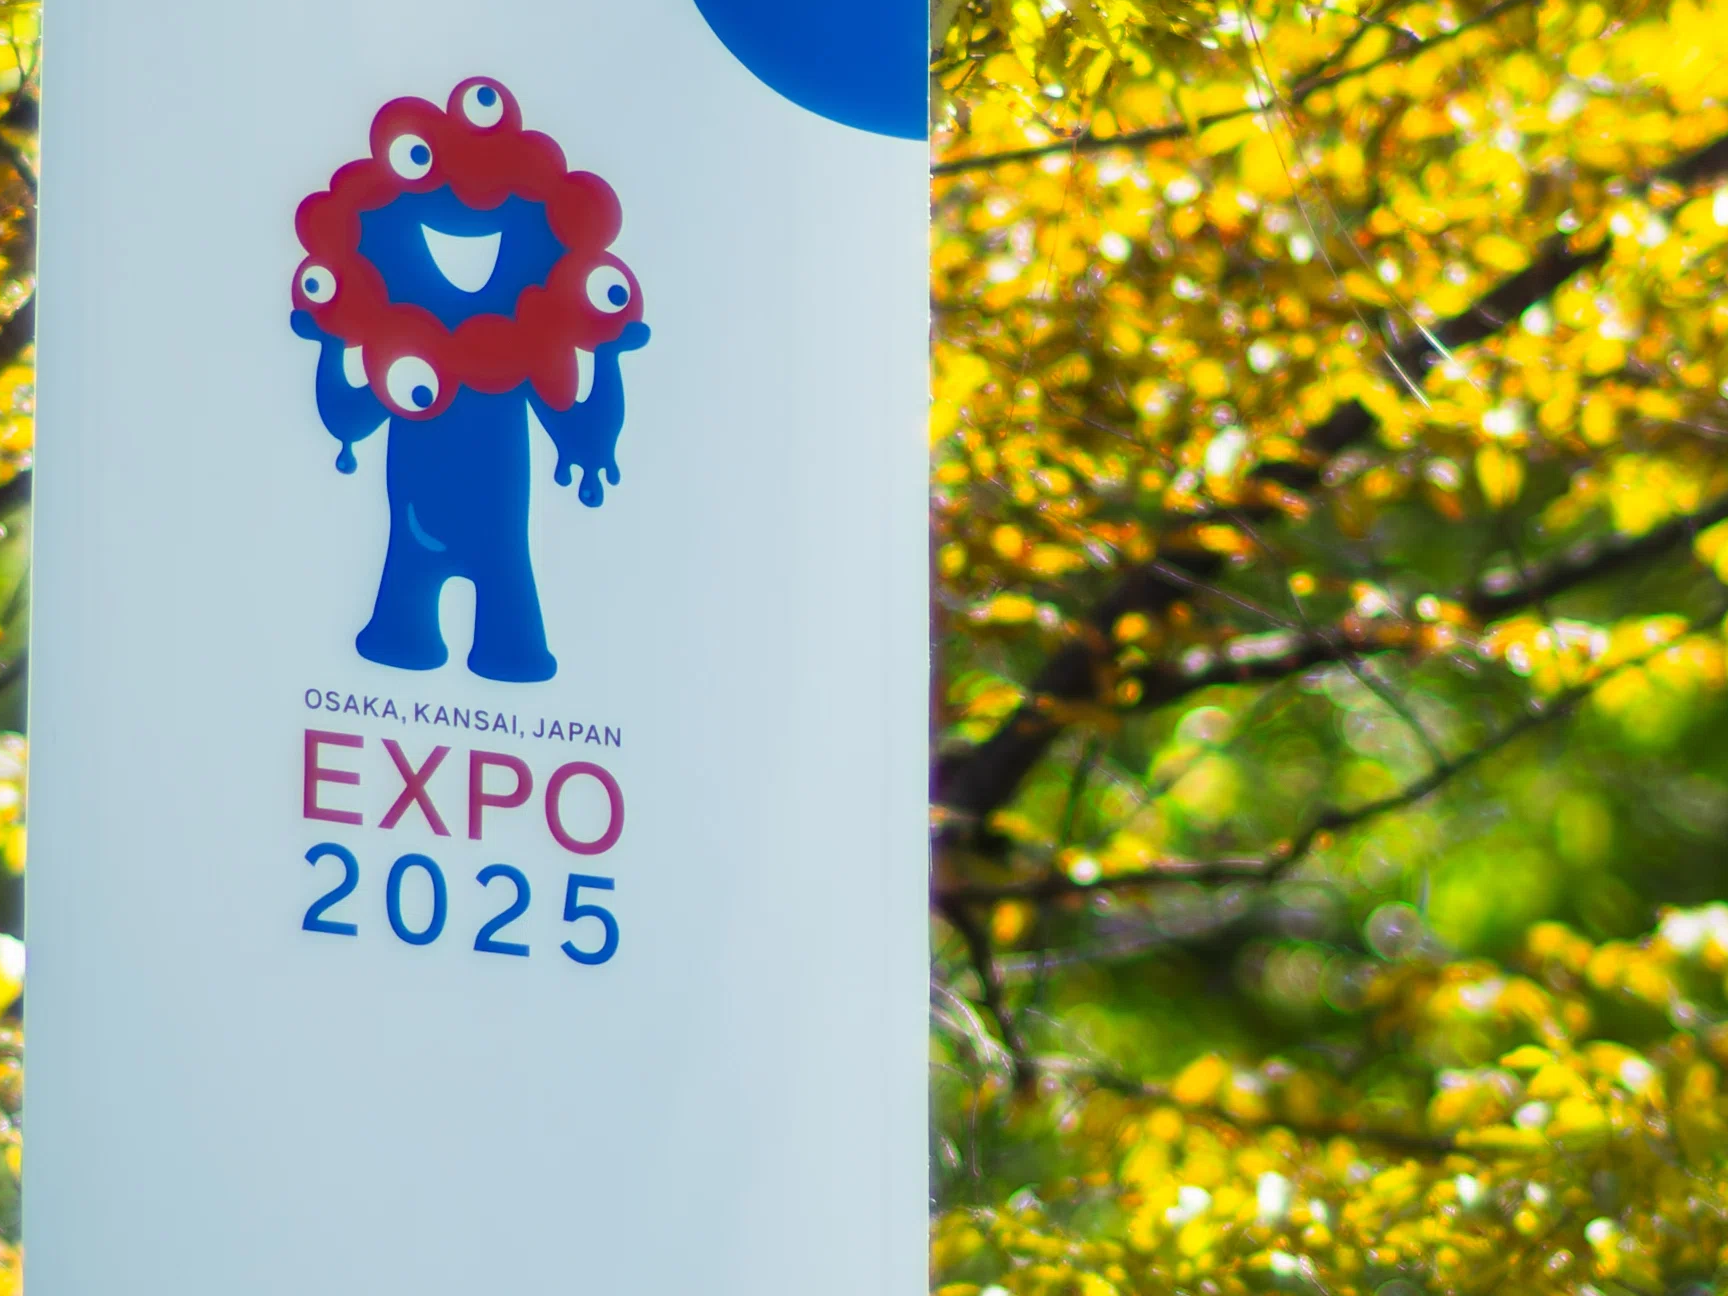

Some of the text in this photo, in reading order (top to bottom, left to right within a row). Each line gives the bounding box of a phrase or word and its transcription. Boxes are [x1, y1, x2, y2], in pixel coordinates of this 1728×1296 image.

[304, 688, 622, 747] OSAKA, KANSAI, JAPAN
[303, 728, 625, 855] EXPO
[301, 842, 619, 965] 2025
